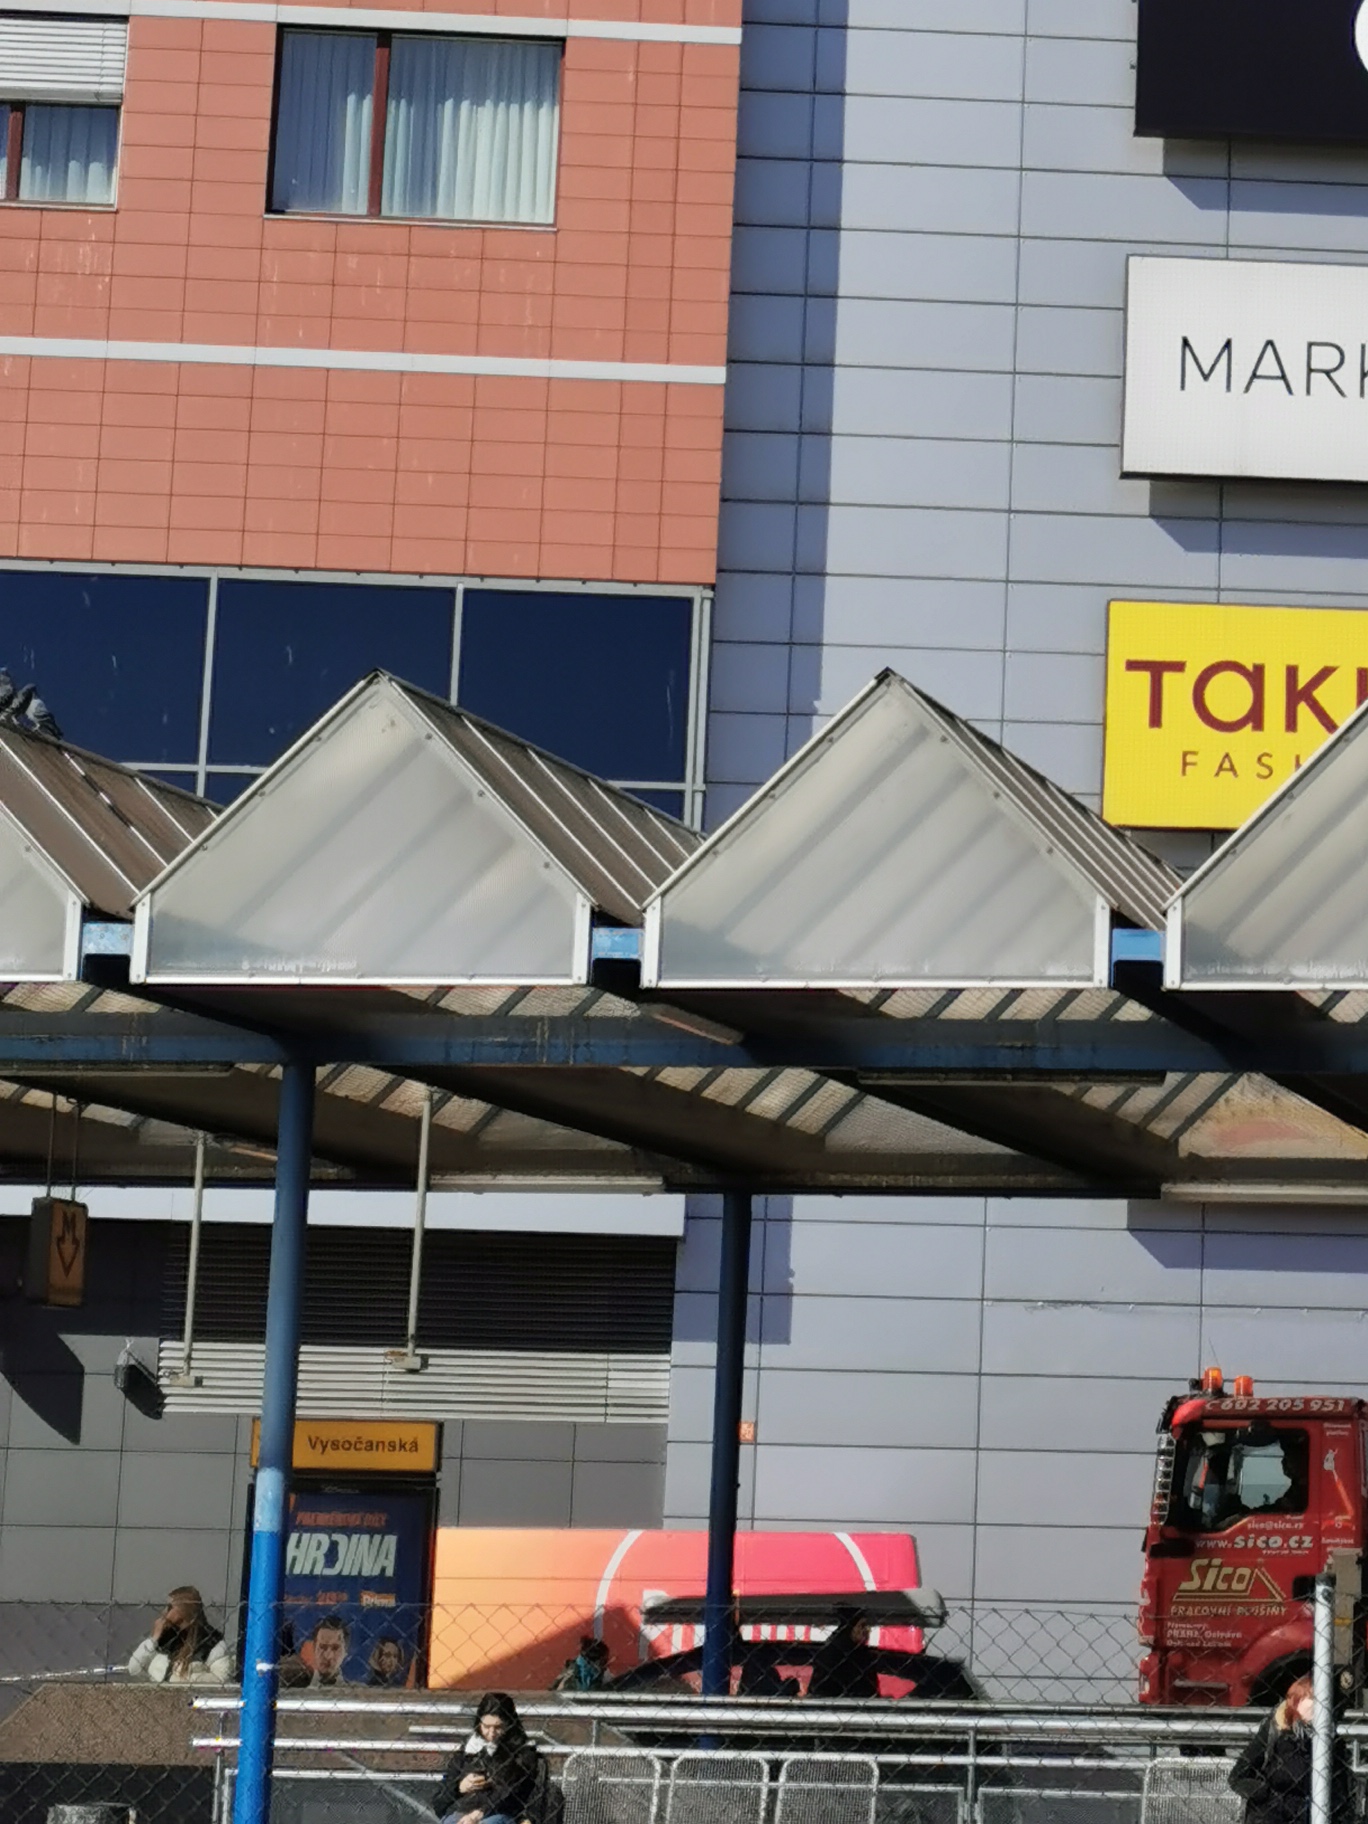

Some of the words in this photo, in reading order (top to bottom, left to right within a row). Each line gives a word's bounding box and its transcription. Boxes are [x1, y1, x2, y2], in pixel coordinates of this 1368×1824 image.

[1181, 750, 1302, 781] FAS
[1221, 1398, 1261, 1411] 602
[1266, 1398, 1305, 1412] 205
[1309, 1399, 1346, 1412] 951
[307, 1436, 419, 1455] Vysočanská
[1178, 1557, 1252, 1591] Sico
